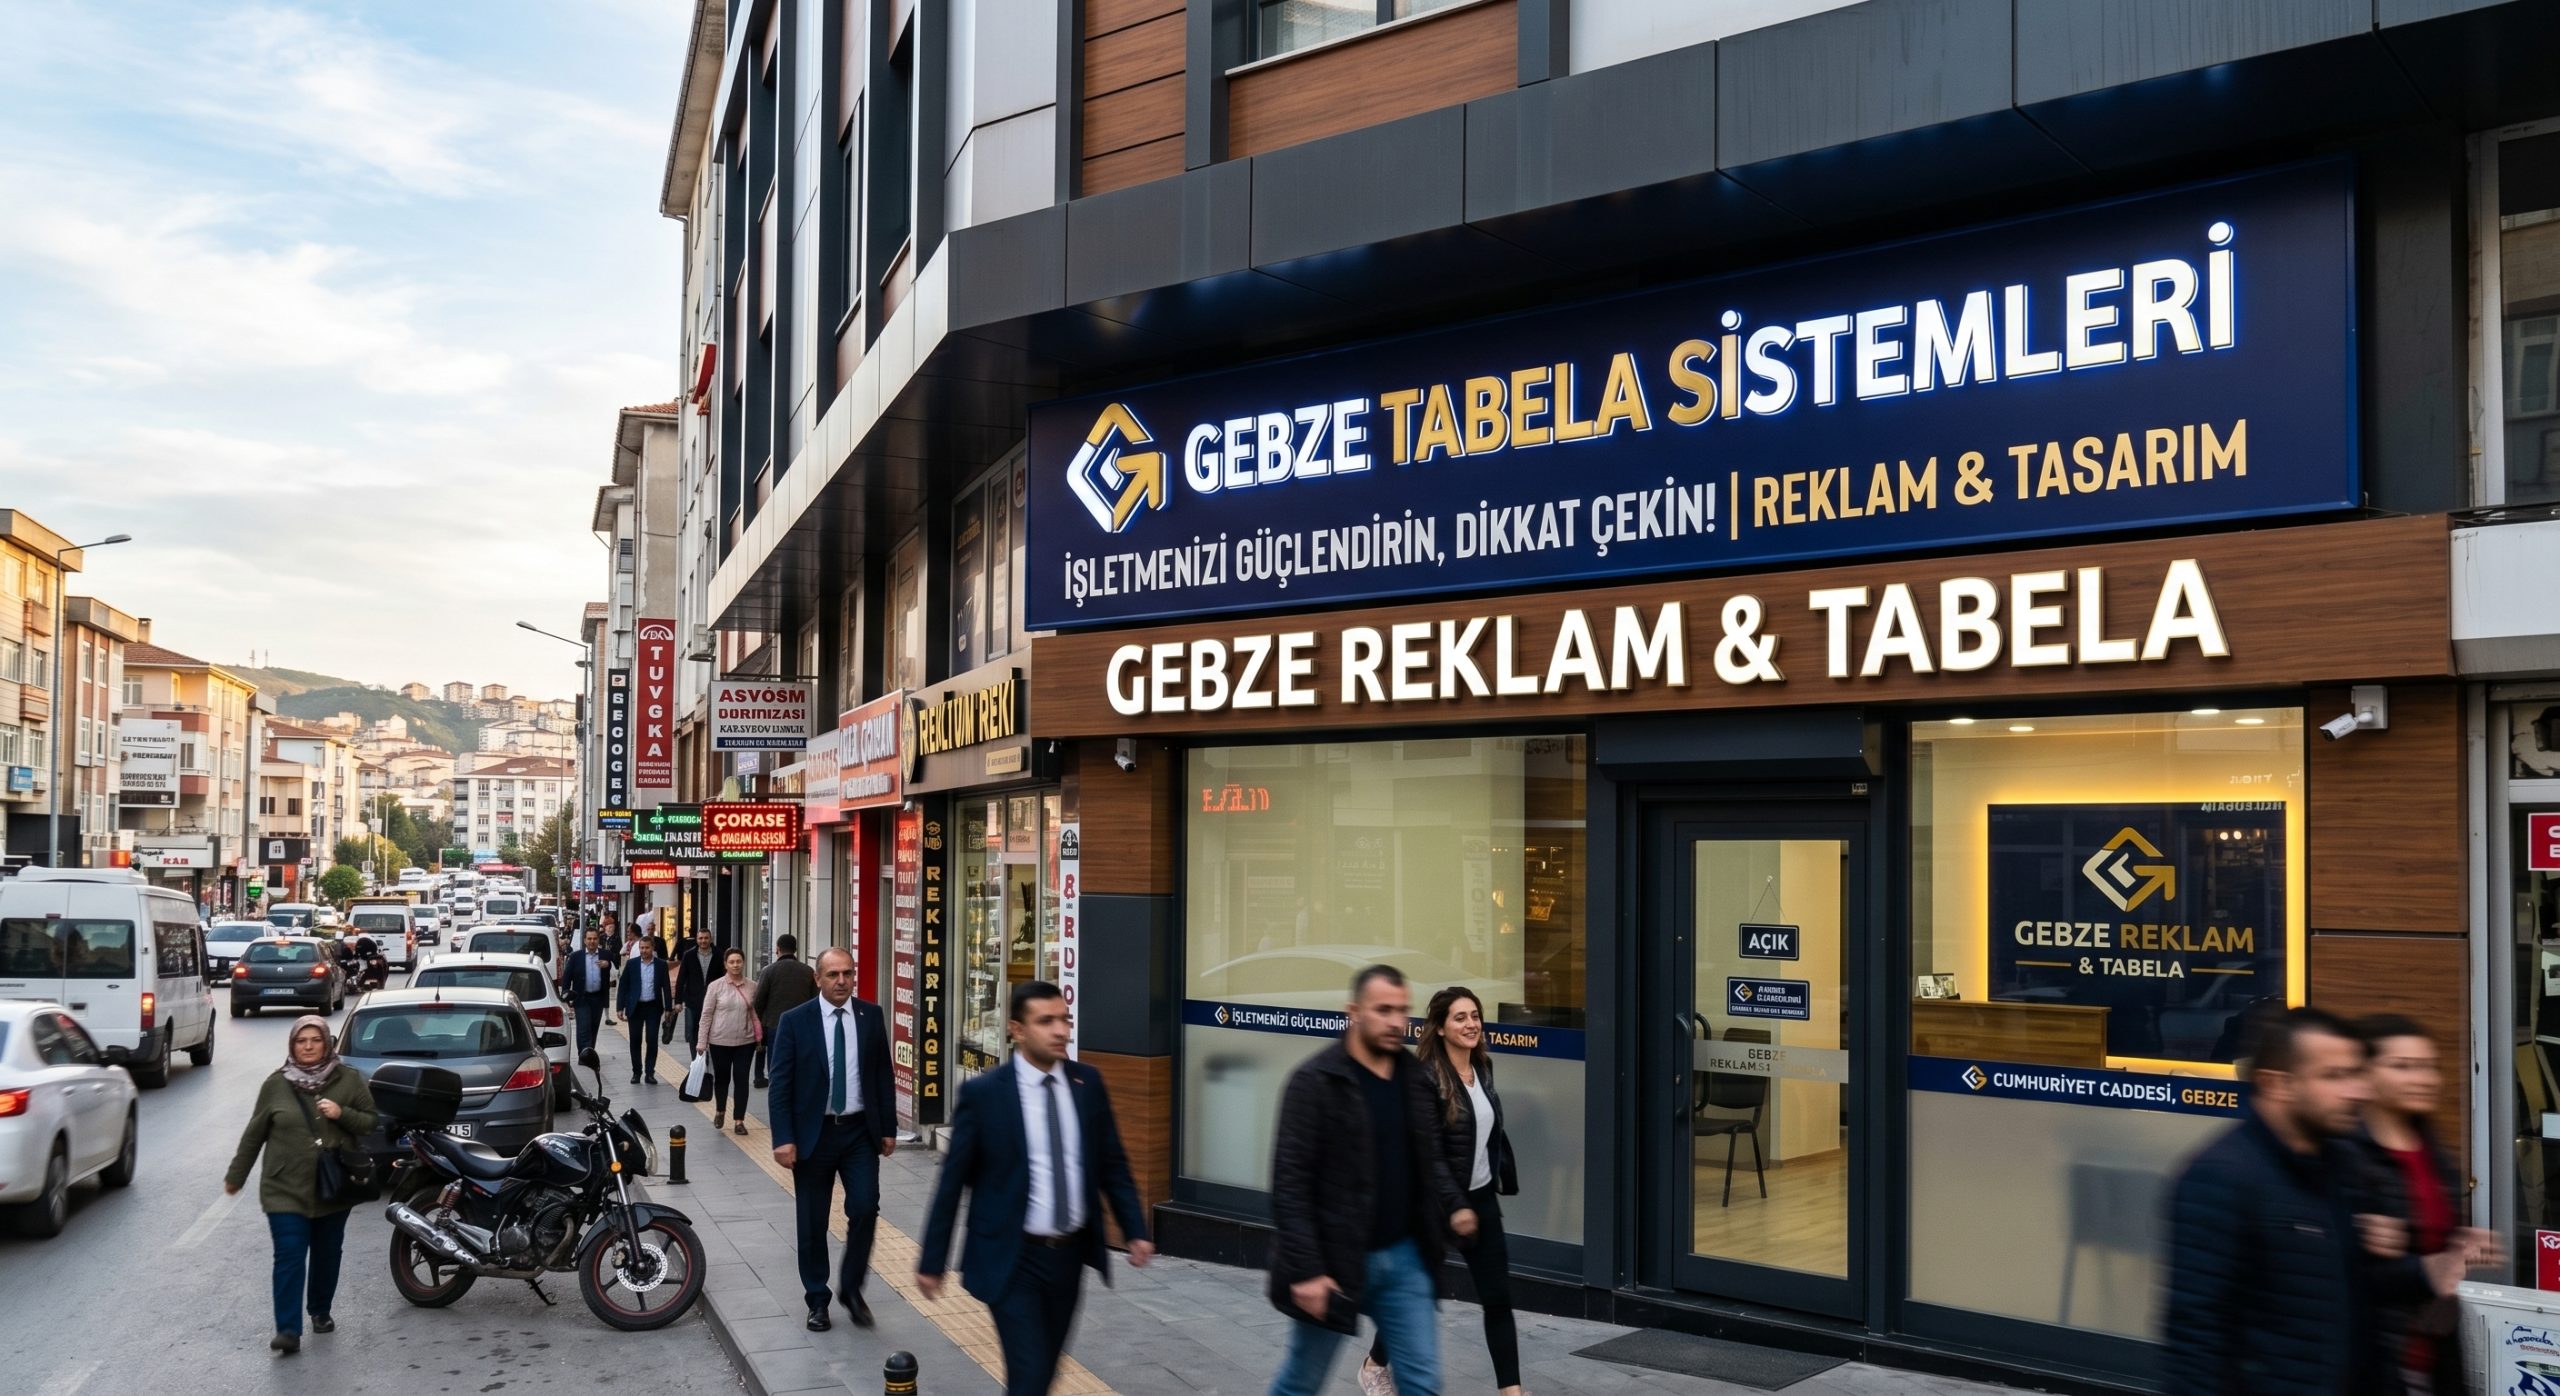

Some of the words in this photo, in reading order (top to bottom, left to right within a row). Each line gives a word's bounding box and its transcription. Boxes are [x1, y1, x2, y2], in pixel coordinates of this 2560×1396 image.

[1184, 398, 1371, 494] GEBZE
[1380, 353, 1652, 465] TABELA
[1668, 221, 2236, 427] SİSTEMLERİ
[1753, 456, 1938, 527] REKLAM
[1953, 450, 1995, 507] &
[2007, 419, 2249, 499] TASARIM
[1064, 533, 1227, 609] İŞLETMENİZİ
[1236, 511, 1446, 590] GÜÇLENDİRİN,
[1456, 499, 1582, 557] DİKKAT
[1591, 474, 1717, 559] ÇEKİN!
[1107, 629, 1319, 718] GEBZE
[1341, 600, 1688, 697] REKLAM
[1713, 593, 1785, 686] &
[1808, 558, 2231, 679] TABELA
[713, 813, 787, 831] ÇORASE
[1748, 932, 1790, 954] AÇIK
[2015, 920, 2112, 948] GEBZE
[2120, 924, 2255, 954] REKLAM
[2078, 956, 2095, 975] &
[2100, 957, 2185, 979] TABELA
[1232, 1009, 1289, 1029] İŞLETMENİZİ
[1489, 1031, 1539, 1049] TASARIM
[1993, 1070, 2097, 1096] CUMHURİYET
[2099, 1078, 2178, 1105] CADDESİ,
[2181, 1089, 2239, 1109] GEBZE
